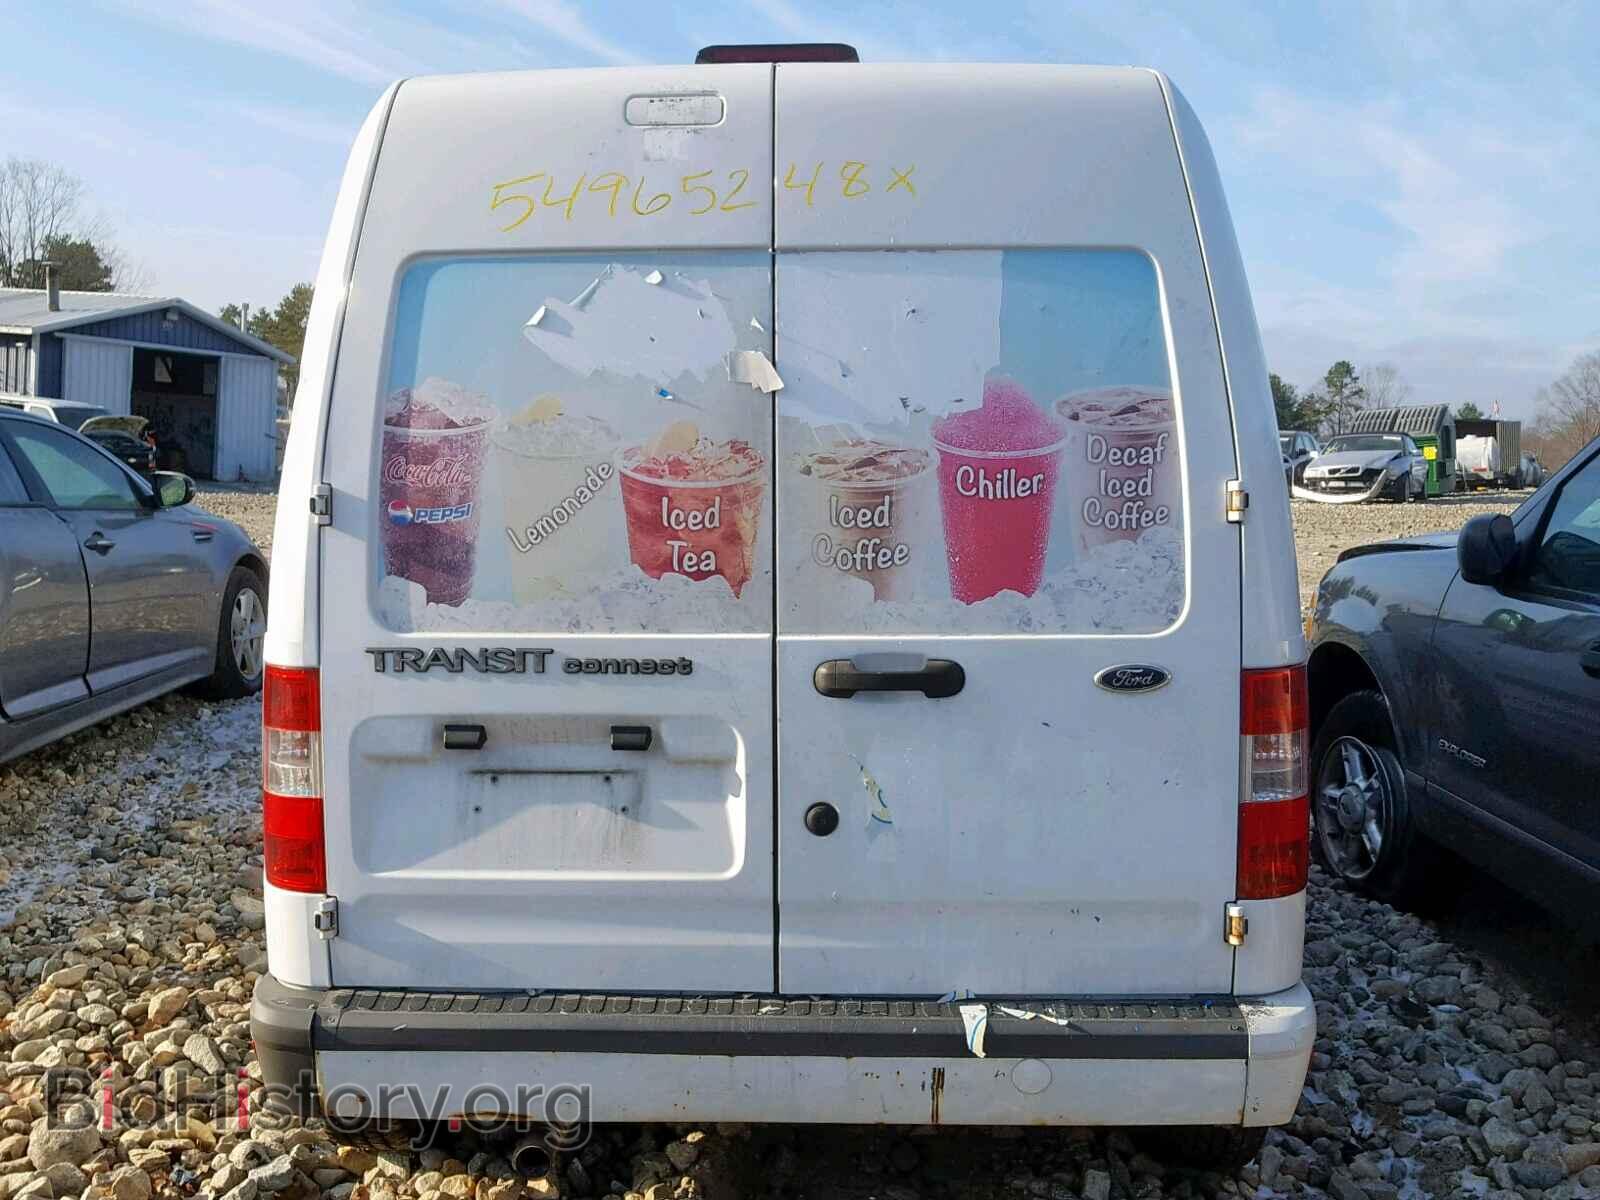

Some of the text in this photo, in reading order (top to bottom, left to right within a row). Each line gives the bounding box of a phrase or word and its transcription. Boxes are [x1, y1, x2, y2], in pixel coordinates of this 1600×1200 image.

[1086, 432, 1168, 466] Decaf
[956, 465, 1045, 500] Chiller
[1100, 469, 1154, 497] Iced
[414, 503, 474, 525] PEPSI
[506, 461, 613, 554] Lemonade
[661, 495, 722, 529] Iced
[829, 494, 893, 528] Iced
[1083, 497, 1169, 530] Coffee
[665, 540, 718, 573] Tea
[811, 532, 911, 571] Coffee
[365, 647, 694, 676] TRANSIT connect
[1112, 668, 1154, 687] Ford
